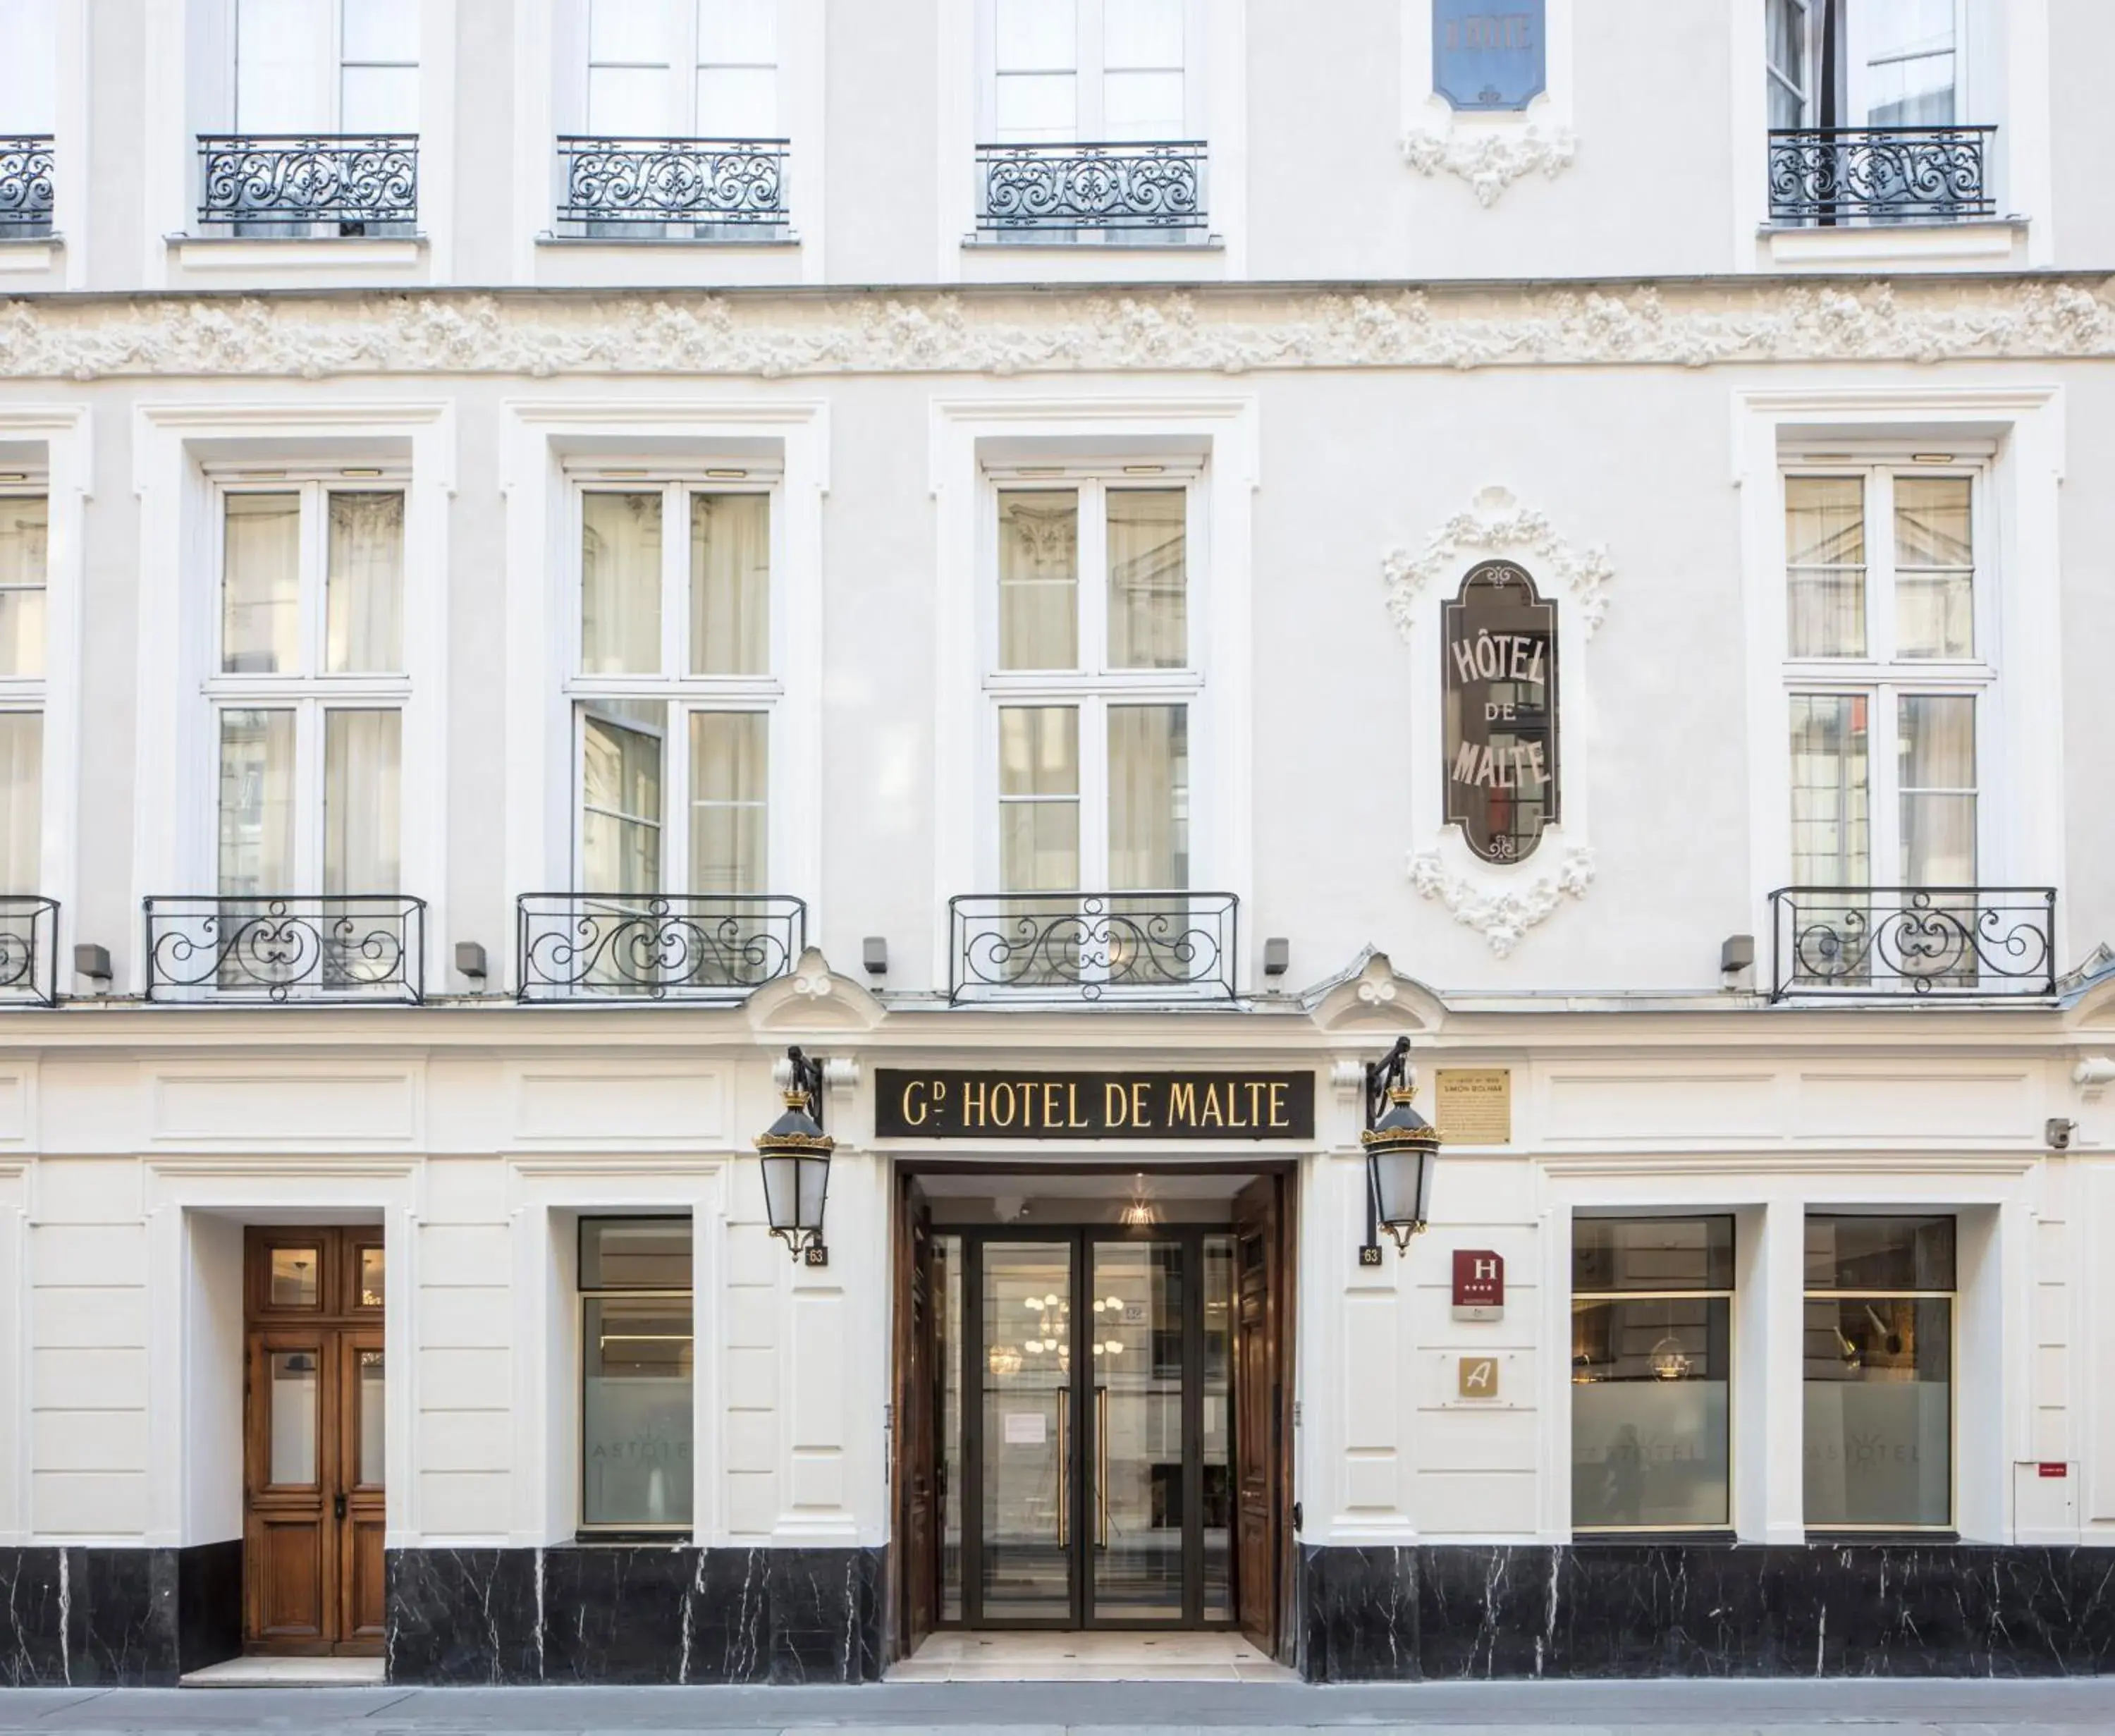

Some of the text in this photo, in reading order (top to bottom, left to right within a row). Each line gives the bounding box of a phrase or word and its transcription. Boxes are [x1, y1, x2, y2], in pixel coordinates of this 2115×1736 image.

[1452, 628, 1545, 685] HÔTEL
[1485, 702, 1516, 721] DE
[1452, 741, 1551, 788] MALTE
[964, 1082, 1089, 1127] HOTEL
[1105, 1083, 1152, 1127] DE
[1167, 1082, 1289, 1127] MALTE
[810, 1249, 823, 1262] 63
[1364, 1249, 1378, 1262] 63
[1473, 1259, 1497, 1279] H
[1467, 1362, 1491, 1387] A
